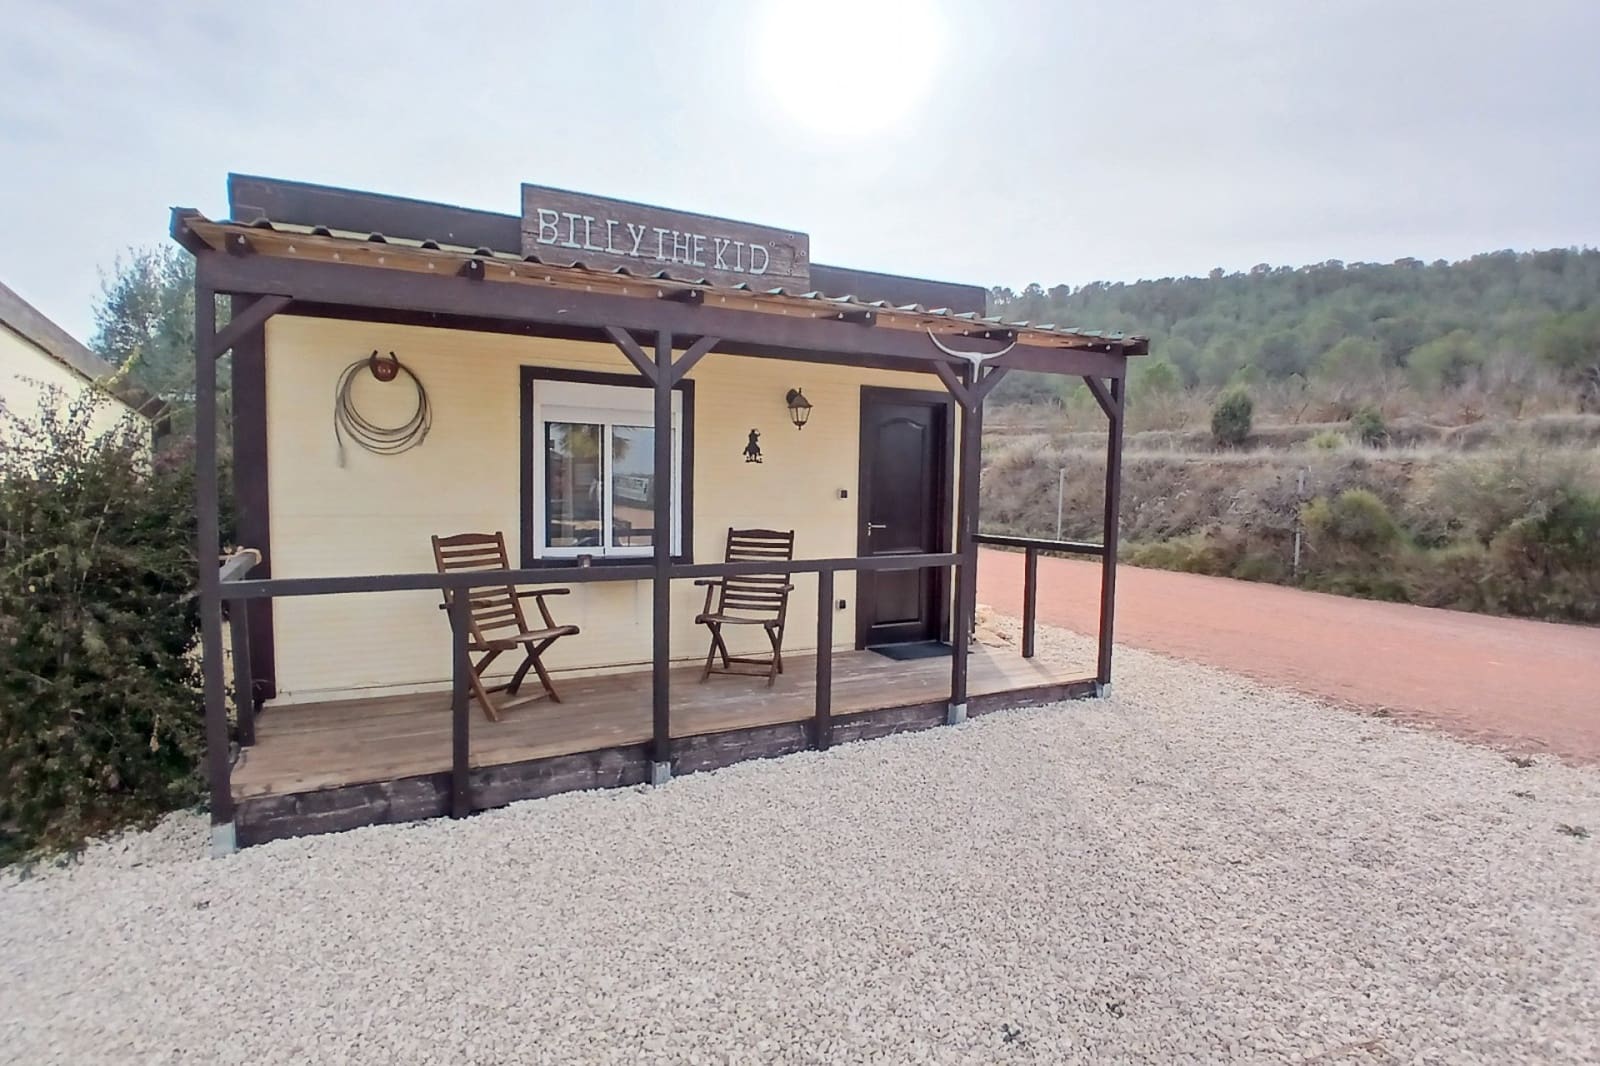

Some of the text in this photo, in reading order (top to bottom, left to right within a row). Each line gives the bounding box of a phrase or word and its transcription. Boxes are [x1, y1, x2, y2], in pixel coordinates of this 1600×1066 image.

[536, 208, 770, 275] BILLY THE KID
